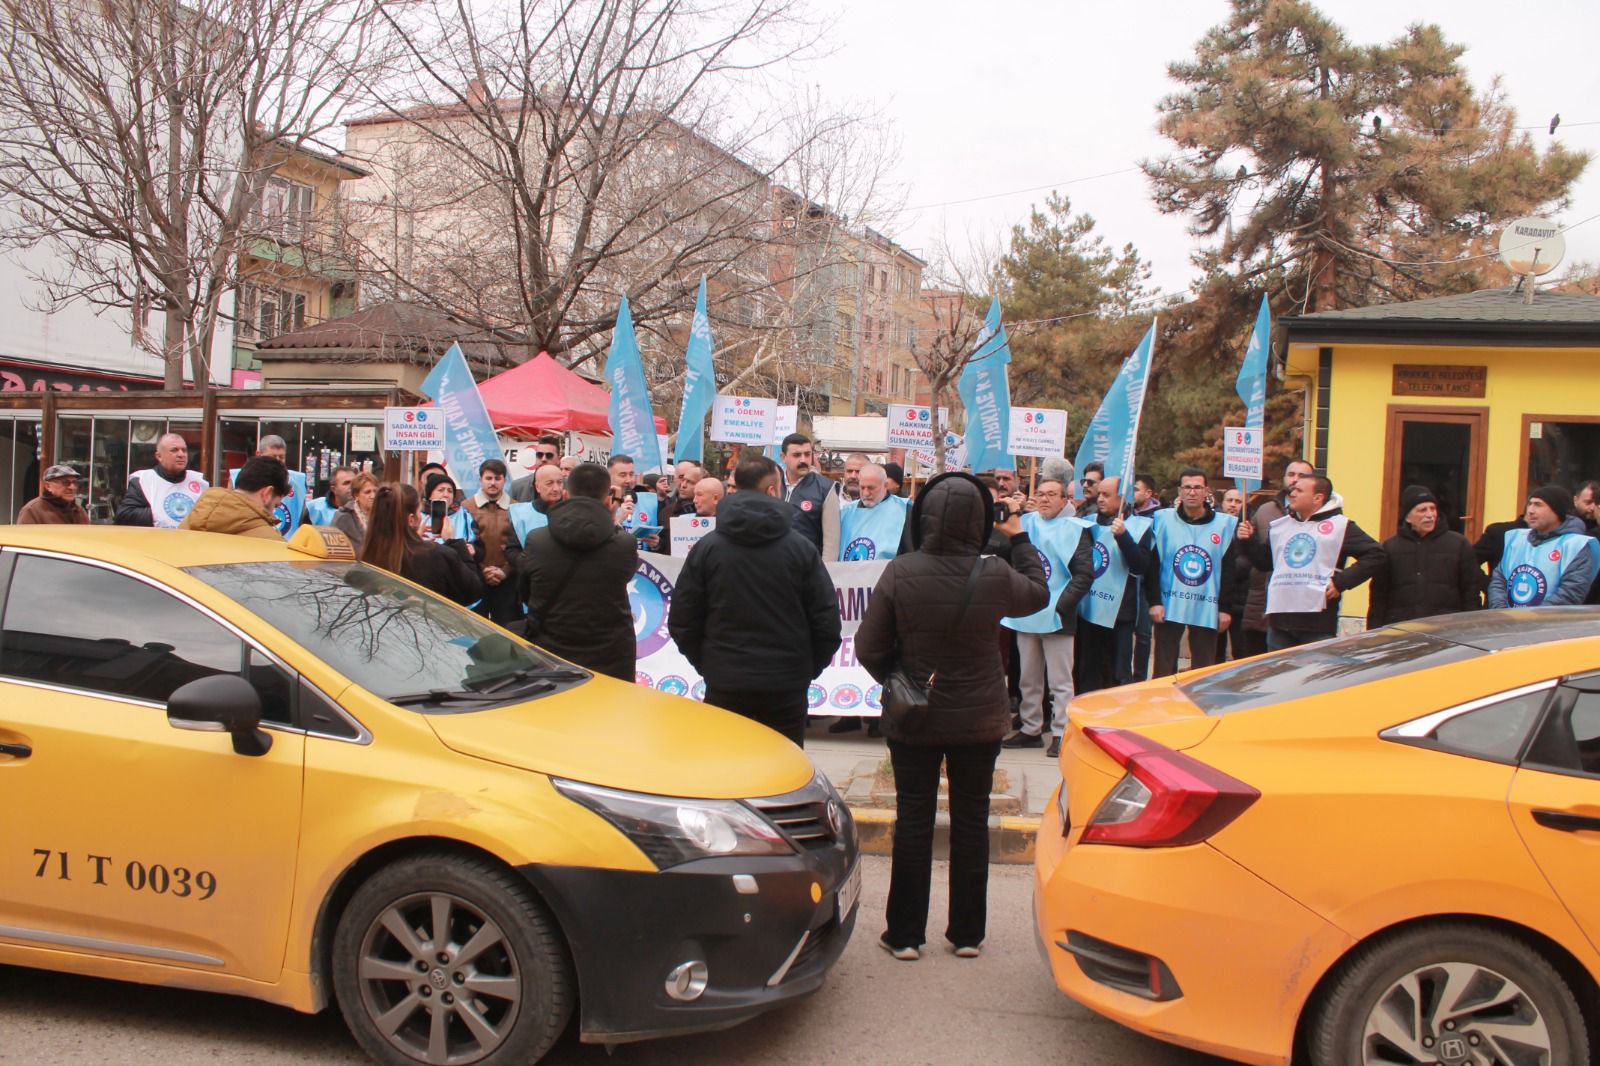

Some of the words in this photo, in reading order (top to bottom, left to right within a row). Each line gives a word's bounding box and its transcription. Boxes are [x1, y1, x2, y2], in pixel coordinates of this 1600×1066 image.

[1515, 225, 1556, 238] KARADAVUT
[1408, 383, 1443, 392] TELEFON
[396, 430, 418, 438] İNSAN
[420, 430, 435, 438] GİBİ
[891, 428, 915, 436] ALANA
[389, 439, 415, 447] YAŞAM
[33, 848, 72, 881] 71
[87, 854, 113, 886] T
[125, 860, 217, 901] 0039
